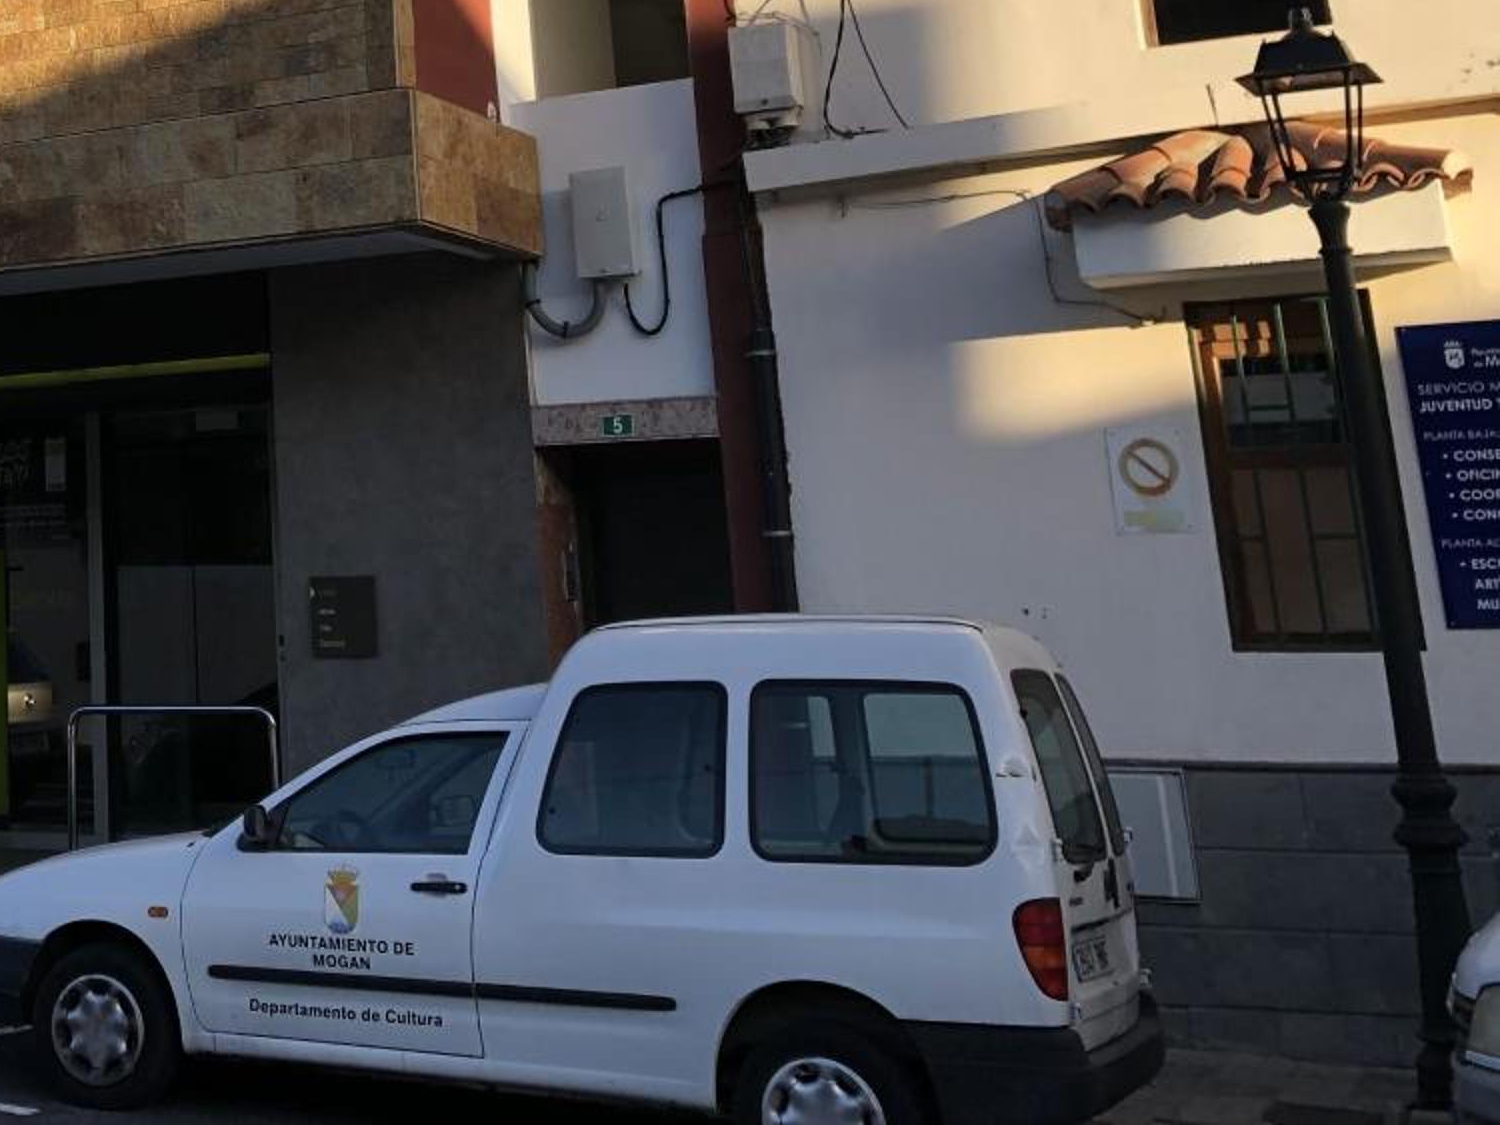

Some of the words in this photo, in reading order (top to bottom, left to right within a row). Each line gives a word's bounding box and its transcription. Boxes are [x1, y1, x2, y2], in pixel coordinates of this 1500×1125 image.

[1417, 380, 1485, 396] SERVICIO
[1420, 398, 1493, 413] JUVENTUD
[612, 416, 624, 434] 5
[1463, 508, 1500, 521] CON
[268, 933, 389, 954] AYUNTAMIENTO
[393, 941, 415, 956] DE
[311, 953, 372, 971] MOGAN
[249, 997, 357, 1021] Departamento
[361, 1006, 381, 1022] de
[385, 1008, 444, 1028] Cultura
